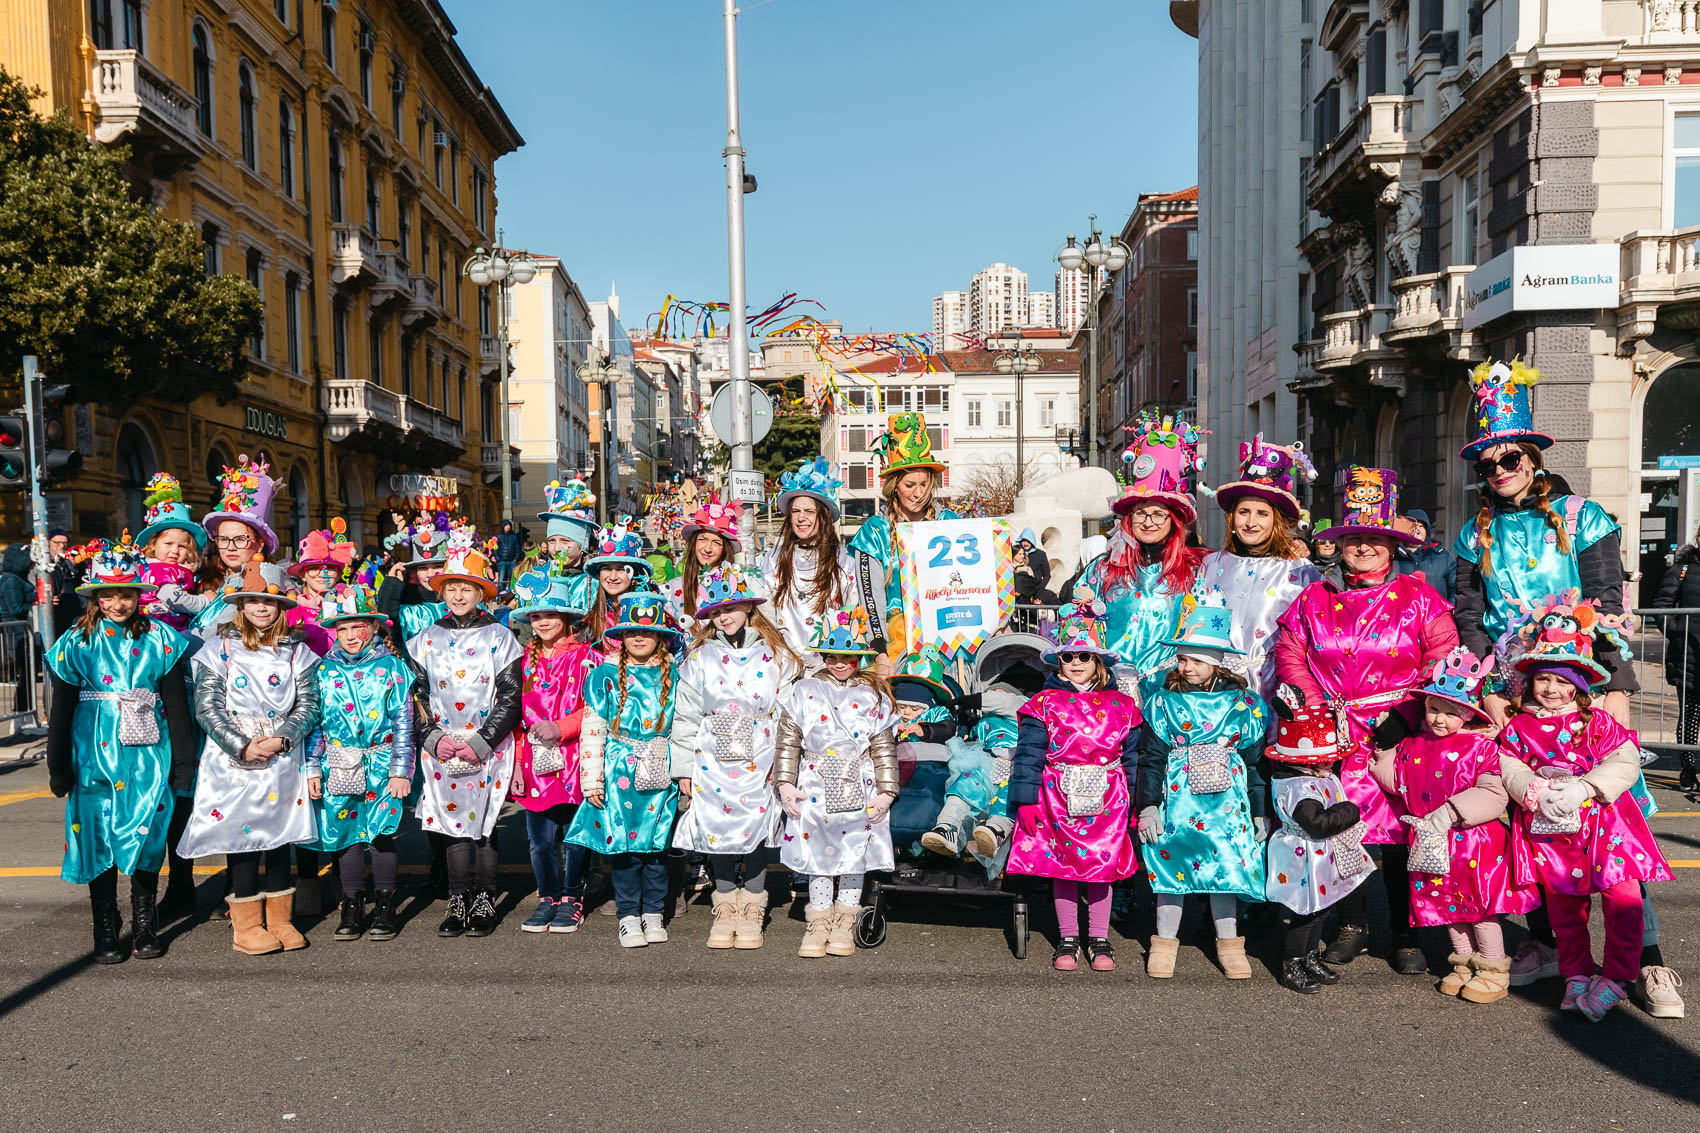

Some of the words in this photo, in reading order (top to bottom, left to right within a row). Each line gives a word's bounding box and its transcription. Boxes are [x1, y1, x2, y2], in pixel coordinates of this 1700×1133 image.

[1521, 273, 1568, 288] Agram
[1570, 274, 1613, 285] Banka
[1465, 287, 1489, 310] Agram
[247, 406, 288, 439] DOUGLAS
[387, 494, 456, 512] CASINO
[927, 533, 982, 568] 23
[945, 611, 965, 620] ERSTE
